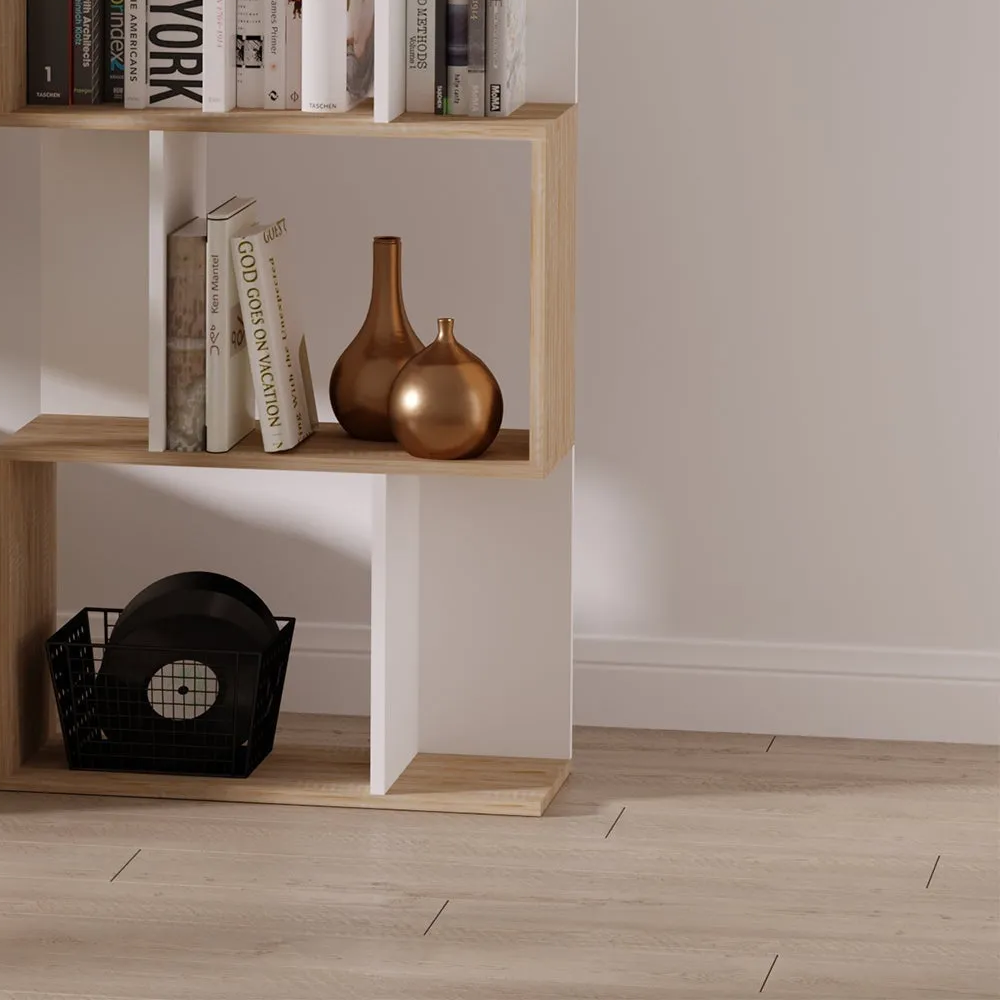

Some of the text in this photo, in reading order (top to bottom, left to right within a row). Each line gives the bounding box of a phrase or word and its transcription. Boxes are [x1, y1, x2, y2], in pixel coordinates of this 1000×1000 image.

[74, 25, 82, 46] Klotz
[82, 15, 92, 68] Architects
[129, 14, 138, 82] AMERICANS
[271, 27, 279, 55] Primer
[417, 8, 428, 70] METHODS
[44, 66, 52, 82] 1
[491, 85, 500, 112] MoMA
[263, 218, 287, 244] GUEST
[211, 254, 219, 314] Ken Mantel
[237, 240, 282, 428] GOD GOES ON VACATION
